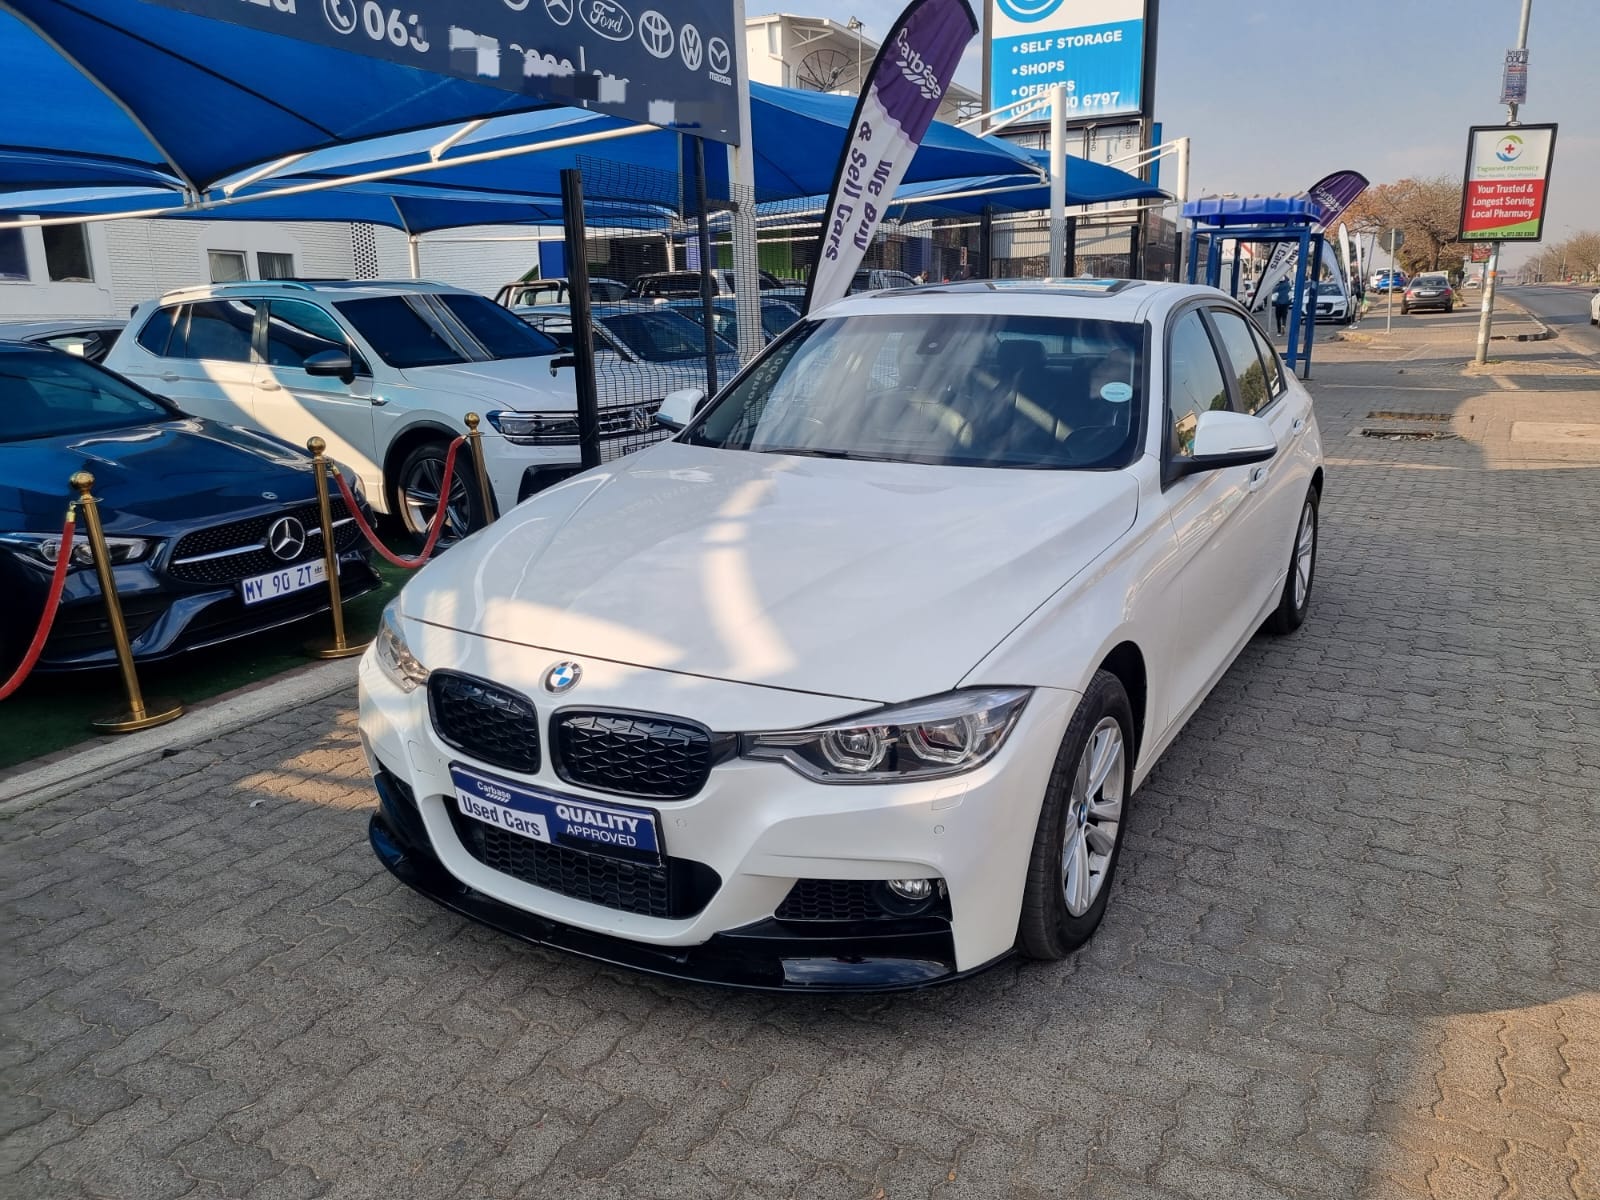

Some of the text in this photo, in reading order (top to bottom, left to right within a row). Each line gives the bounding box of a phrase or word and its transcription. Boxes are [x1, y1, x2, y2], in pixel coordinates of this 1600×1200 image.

[590, 1, 623, 33] Ford
[1020, 30, 1123, 54] SELF STORAGE
[897, 27, 942, 99] Carbase
[1019, 60, 1065, 76] SHOPS
[1083, 91, 1120, 107] 6797
[825, 121, 873, 262] & Sell Cars
[1477, 183, 1534, 194] Your Trusted &
[853, 160, 893, 252] We Buy
[1471, 208, 1533, 220] Local Pharmacy
[1472, 196, 1536, 208] Longest Serving
[245, 579, 263, 601] MY
[297, 565, 312, 587] ZT
[477, 781, 512, 799] Carbase
[462, 795, 541, 836] Used Cars
[555, 804, 639, 833] QUALITY
[566, 823, 638, 848] APPROVED
